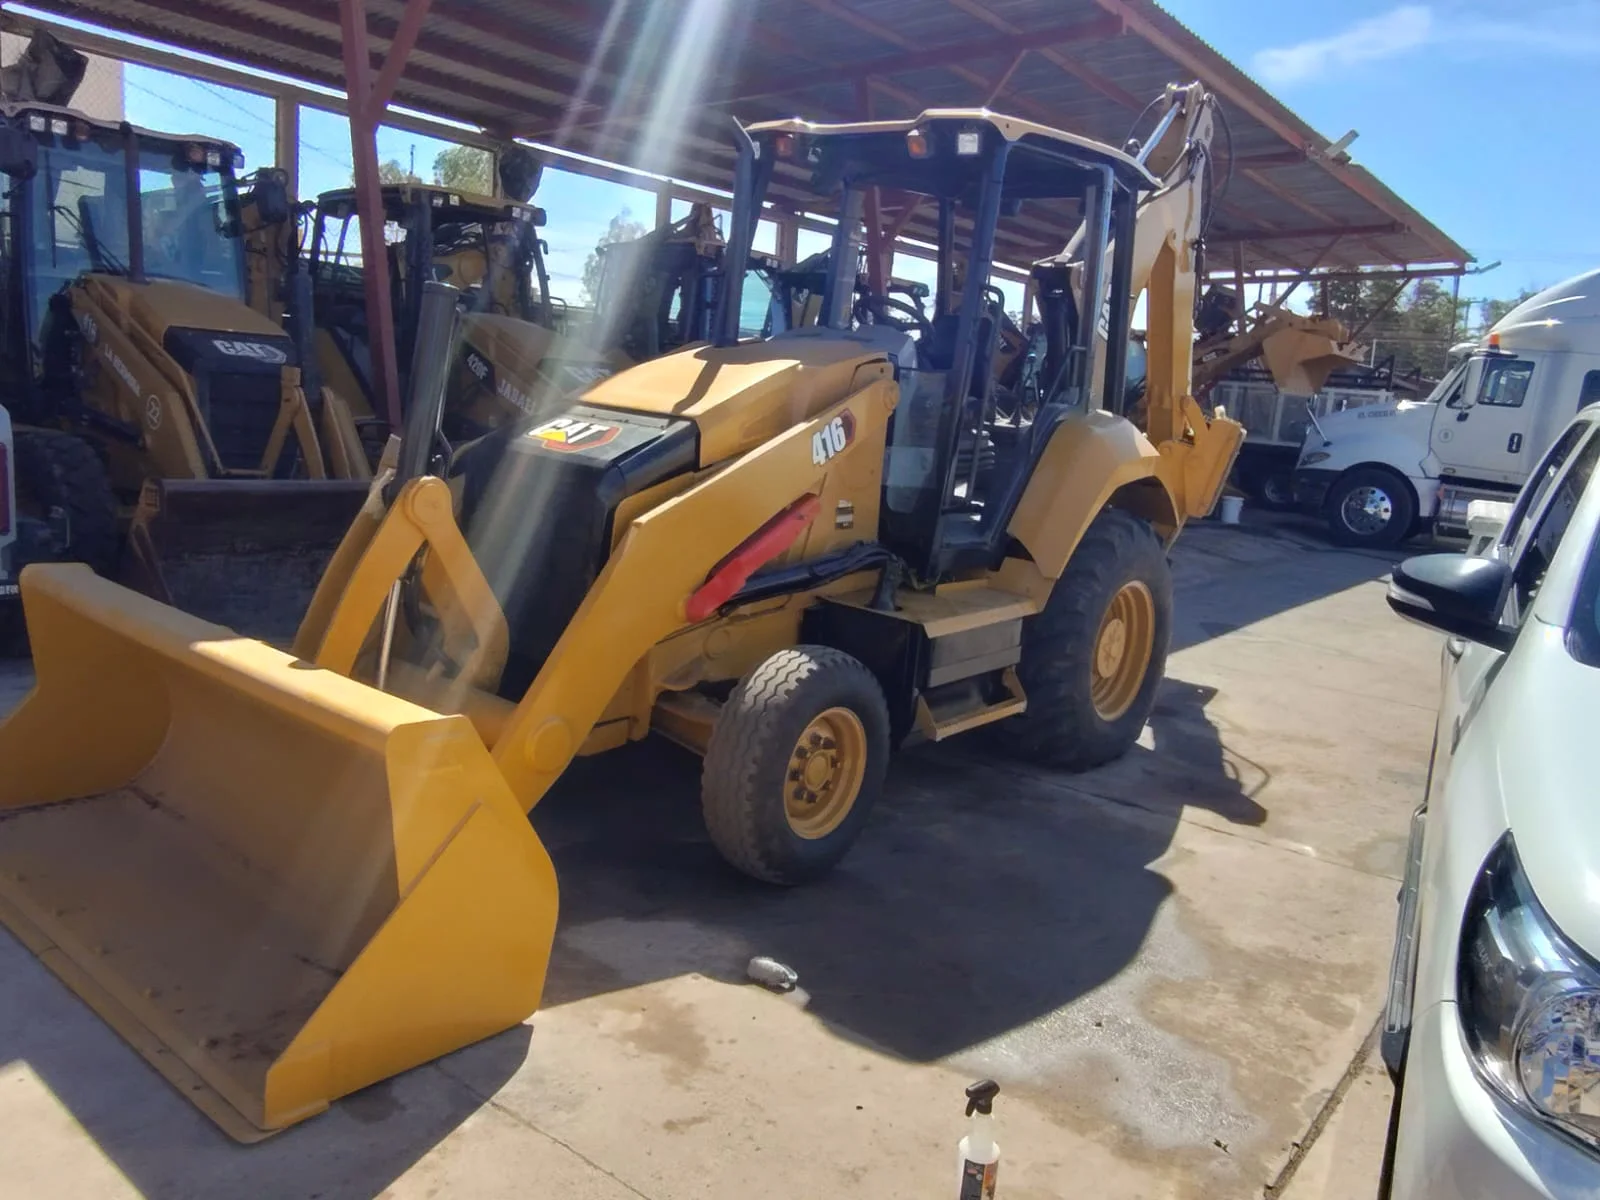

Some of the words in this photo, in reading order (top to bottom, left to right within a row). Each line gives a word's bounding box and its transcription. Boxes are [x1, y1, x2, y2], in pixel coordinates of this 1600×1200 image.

[212, 339, 270, 360] CAT
[528, 418, 611, 444] CAT
[812, 416, 846, 465] 416
